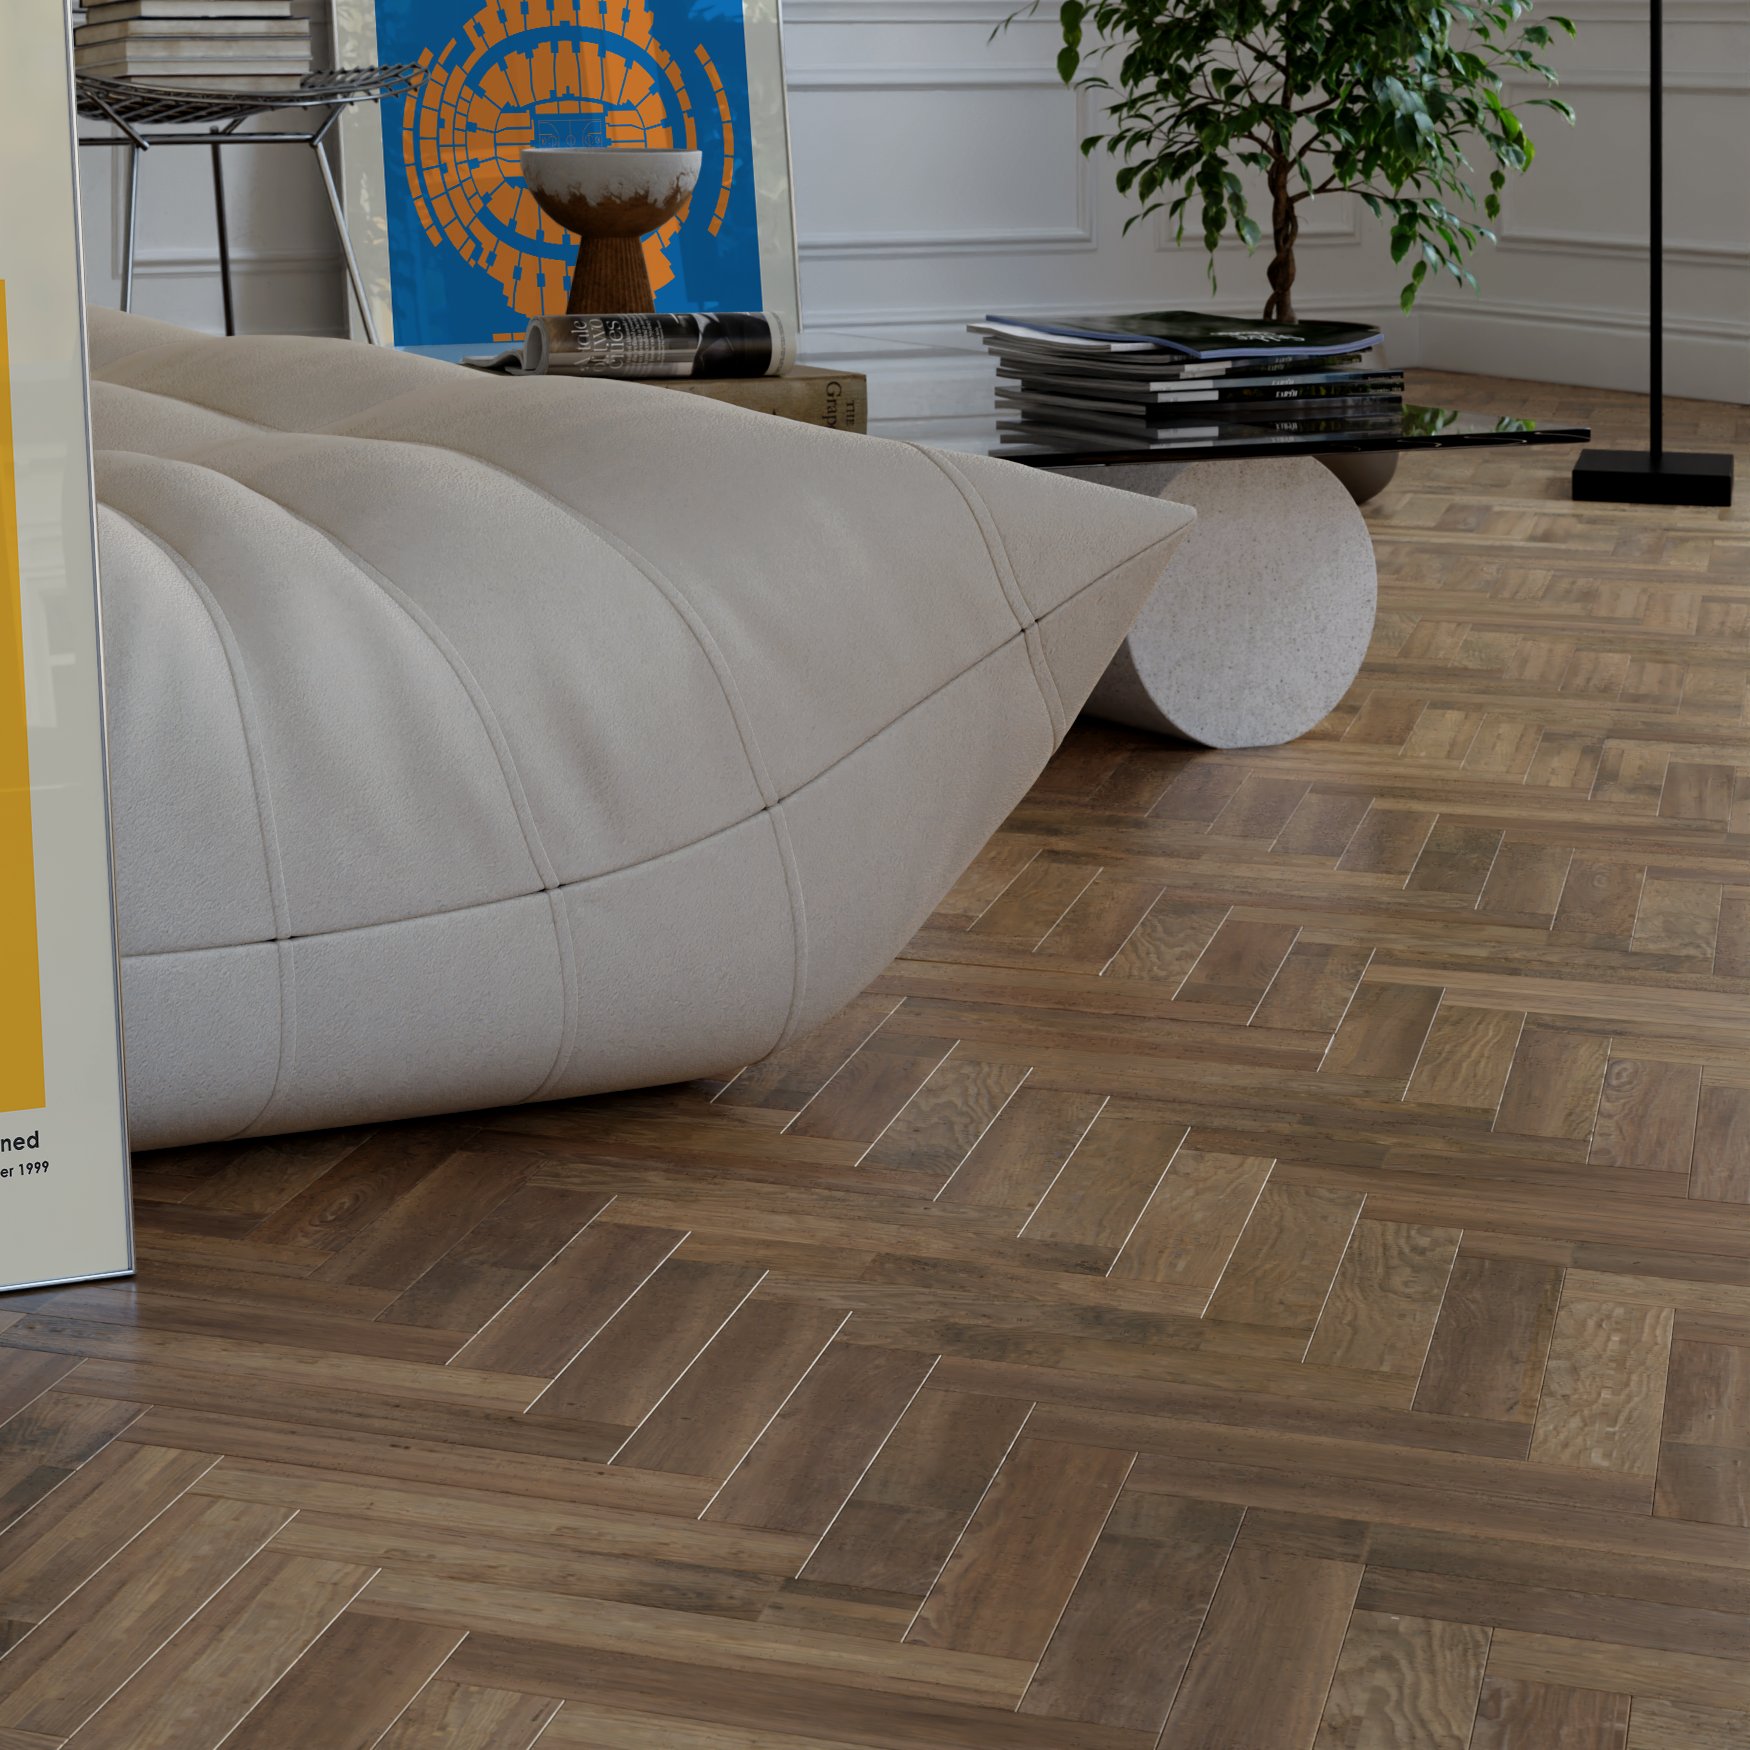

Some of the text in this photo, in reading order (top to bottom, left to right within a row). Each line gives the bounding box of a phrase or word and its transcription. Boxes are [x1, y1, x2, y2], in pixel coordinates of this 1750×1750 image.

[571, 320, 591, 371] A tale
[589, 319, 608, 372] of two
[606, 320, 624, 369] cities
[846, 400, 855, 426] THE
[19, 1161, 49, 1175] 1999
